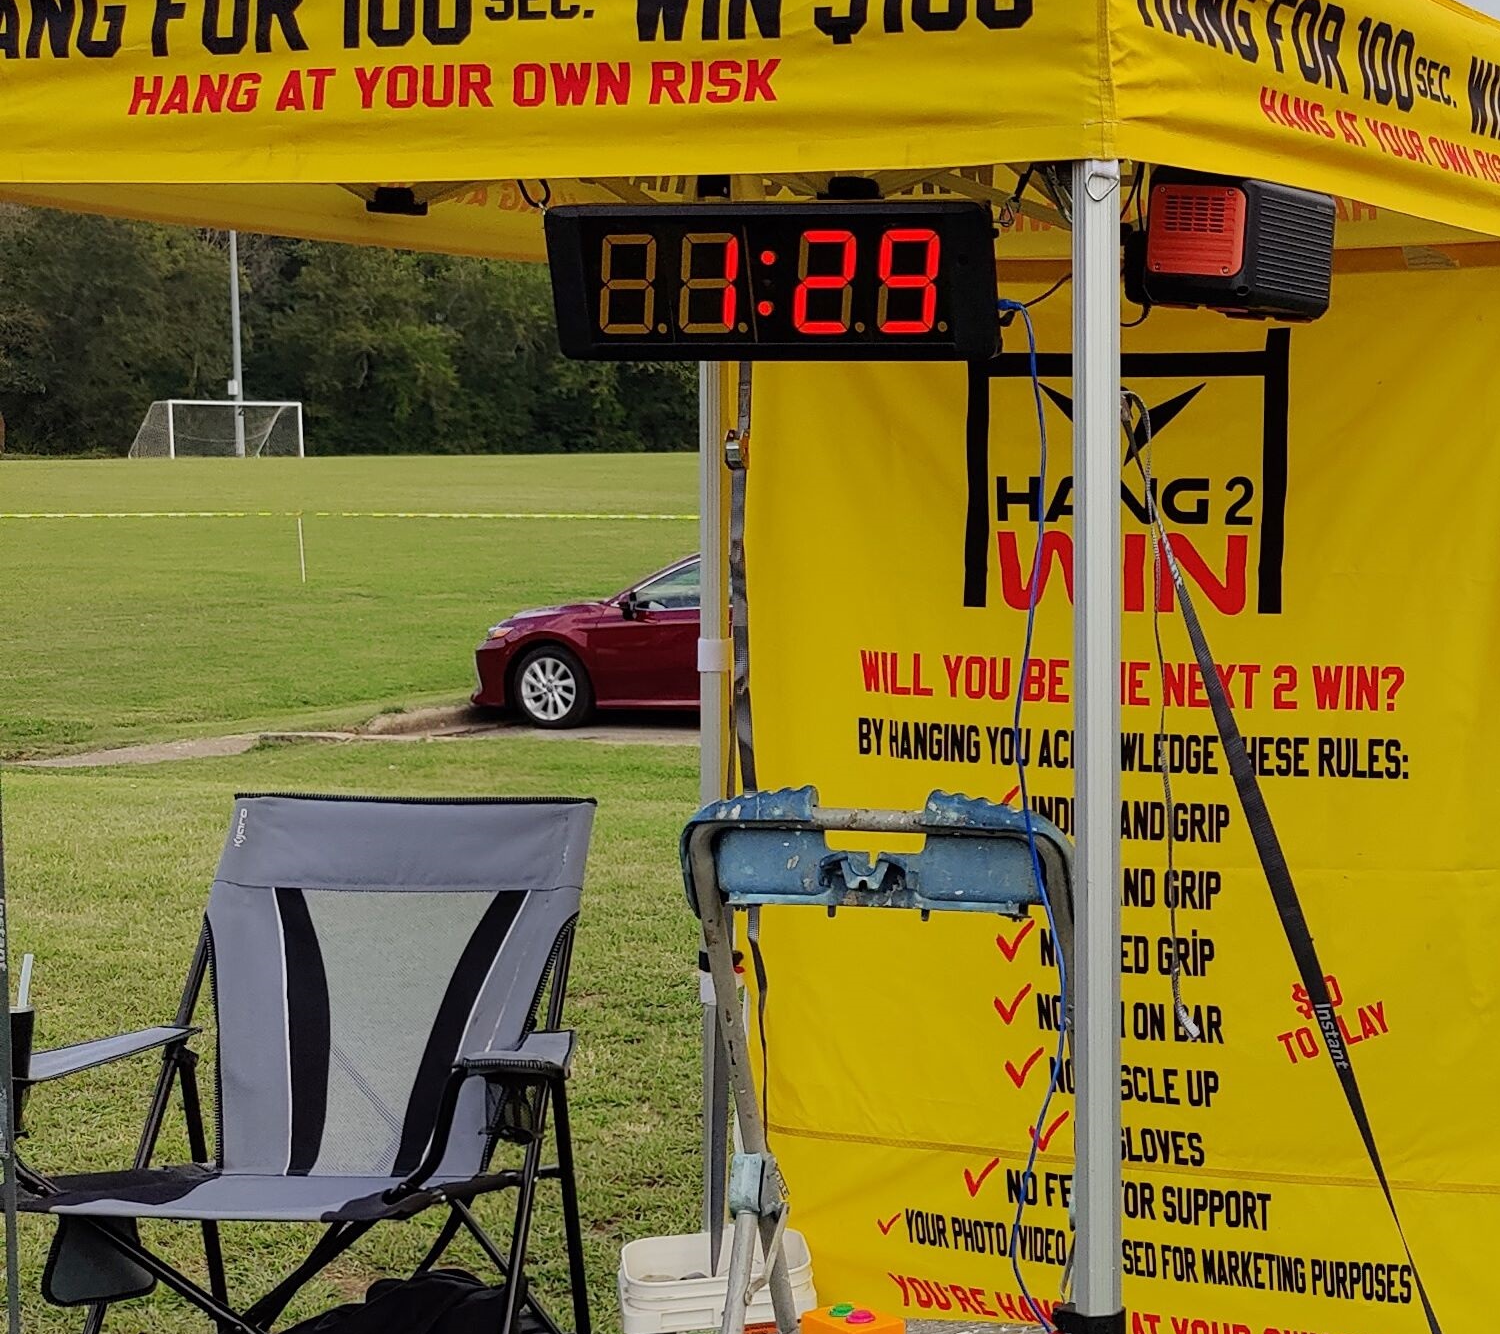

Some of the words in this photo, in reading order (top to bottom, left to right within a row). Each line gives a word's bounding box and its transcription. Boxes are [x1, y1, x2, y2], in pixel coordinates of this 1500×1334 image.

[128, 72, 261, 115] HANG
[276, 68, 336, 111] AT
[354, 63, 494, 109] YOUR
[513, 62, 630, 107] OWN
[648, 58, 781, 105] RISK
[1358, 17, 1415, 113] 100
[1415, 57, 1457, 108] SEC.
[1260, 86, 1335, 139] HANG
[1336, 110, 1366, 147] AT
[1365, 117, 1432, 166] YOUR
[1429, 137, 1477, 178] OWN
[1225, 476, 1253, 525] 2
[997, 530, 1248, 616] WIN
[860, 650, 933, 696] WILL
[943, 655, 1010, 700] YOU
[1023, 658, 1069, 703] BE
[1273, 665, 1298, 710] 2
[1312, 665, 1404, 712] WIN?
[858, 717, 883, 755] BY
[889, 720, 980, 763] HANGING
[986, 726, 1031, 766] YOU
[1038, 729, 1218, 774] ACWLEDGE
[1232, 736, 1309, 777] HESE
[1318, 737, 1409, 780] RULES:
[233, 808, 248, 847] Kijaro
[1173, 803, 1230, 843] GRIP
[1164, 869, 1222, 910] GRIP
[1133, 1002, 1165, 1042] ON
[1292, 975, 1343, 1019] $0
[1277, 1027, 1319, 1064] TO
[1336, 1000, 1389, 1046] LAY
[1315, 1003, 1350, 1070] Instant
[1120, 1065, 1181, 1105] SCLE
[1187, 1070, 1219, 1107] UP
[1006, 1169, 1038, 1206] NO
[1121, 1181, 1156, 1220] OR
[1162, 1185, 1272, 1231] SUPPORT
[905, 1208, 949, 1248] YOUR
[1122, 1238, 1157, 1279] SED
[1161, 1244, 1199, 1283] FOR
[1202, 1248, 1306, 1295] MARKETING
[1312, 1258, 1412, 1304] PURPOSES
[888, 1272, 999, 1317] YOU'RE
